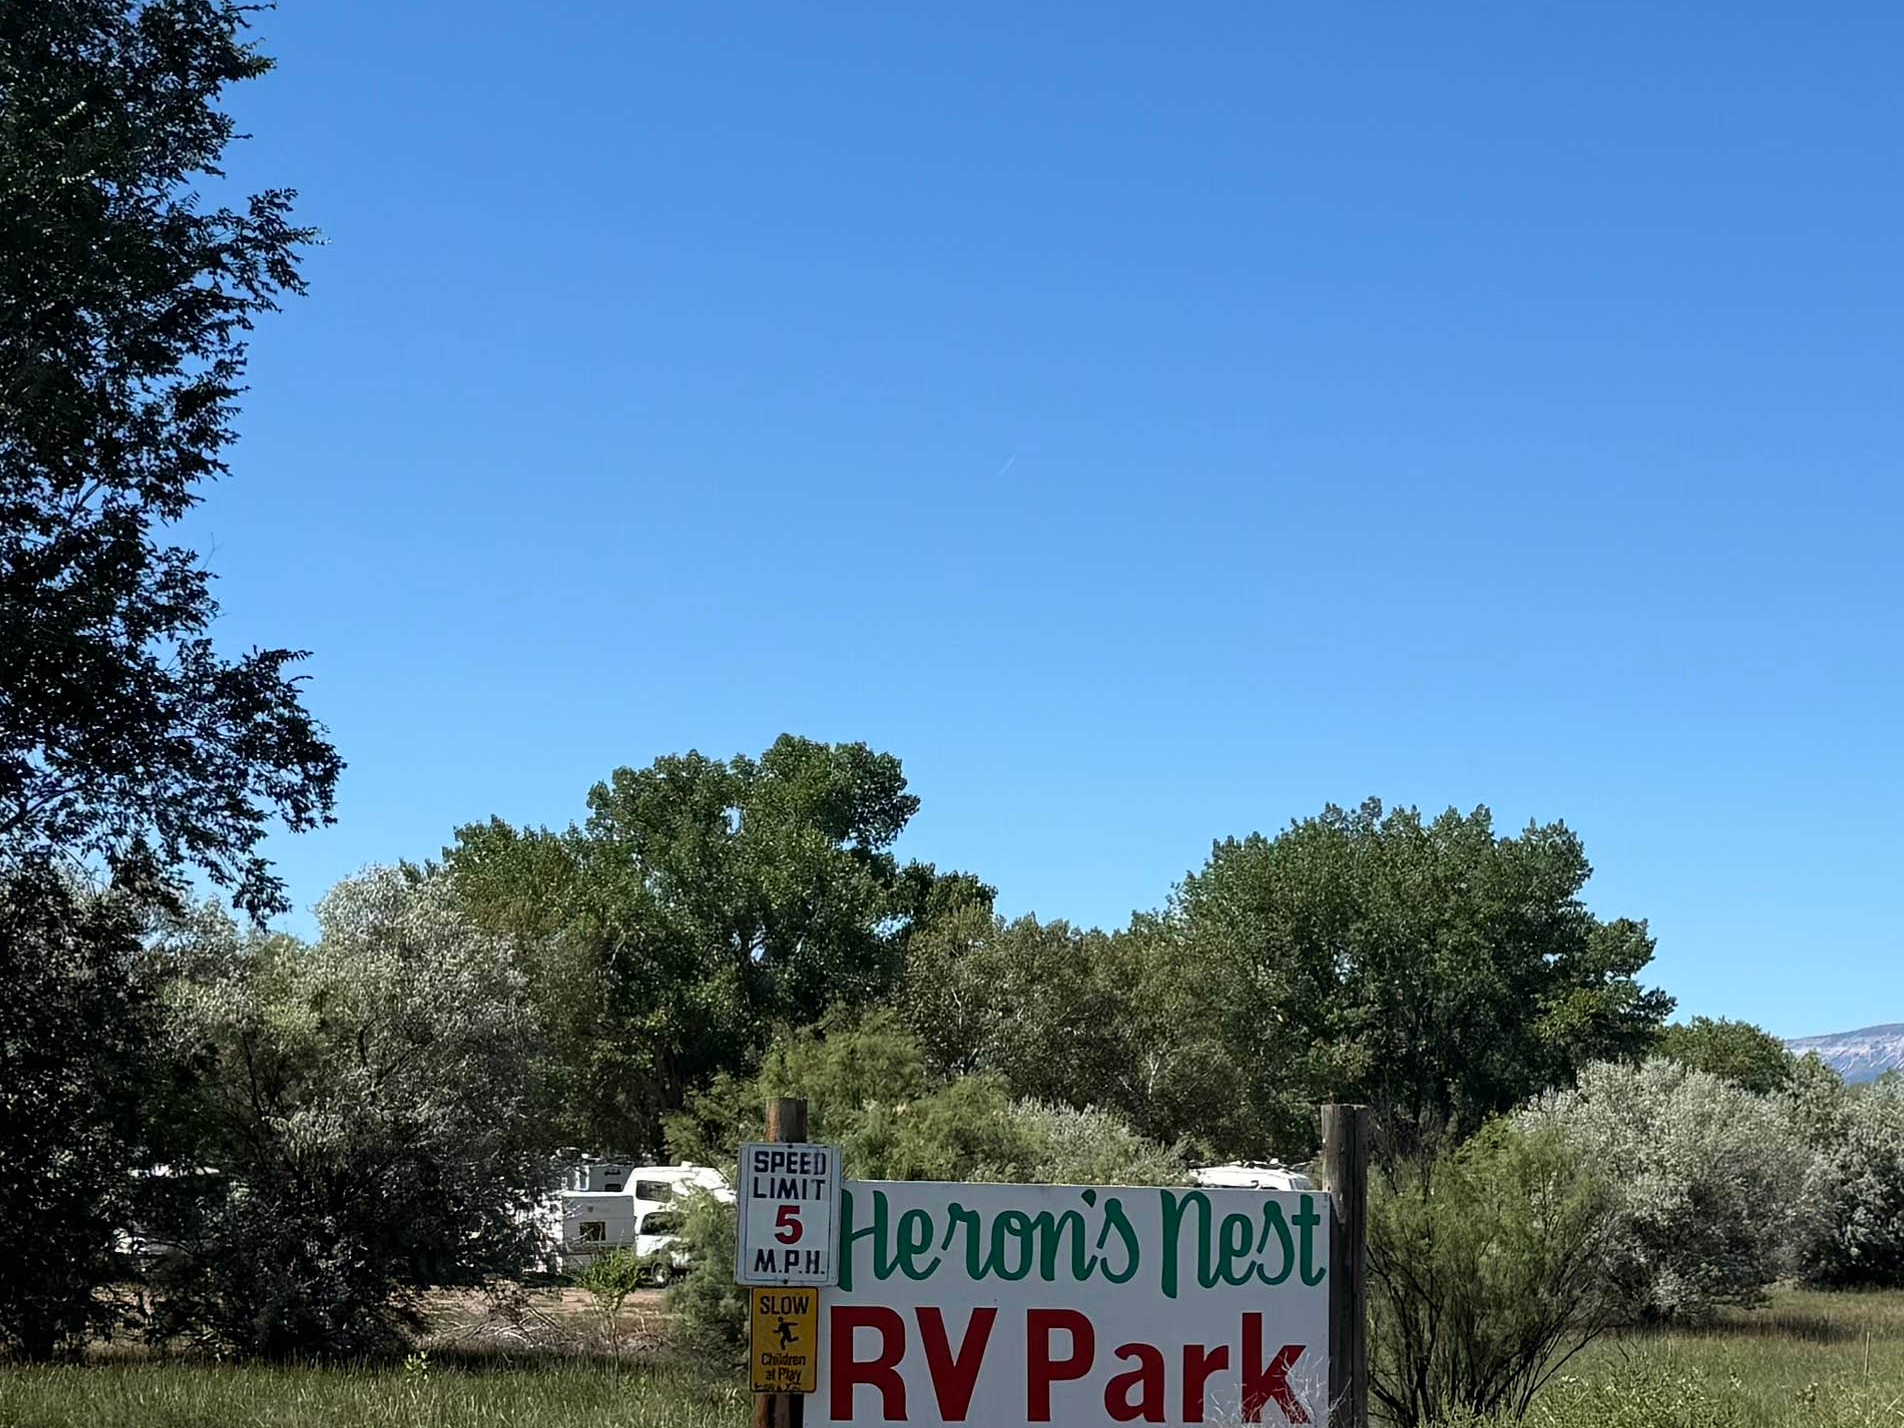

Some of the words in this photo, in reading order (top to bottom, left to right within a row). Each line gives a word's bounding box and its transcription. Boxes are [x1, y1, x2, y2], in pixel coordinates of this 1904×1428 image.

[754, 1151, 827, 1175] SPEED
[753, 1176, 826, 1200] LIMIT
[774, 1205, 804, 1245] 5
[838, 1188, 1140, 1292] Heron's
[1159, 1188, 1327, 1299] Nest
[754, 1248, 826, 1274] M.P.H.
[760, 1295, 810, 1315] SLOW
[761, 1352, 807, 1366] Children
[830, 1305, 999, 1422] RV
[1026, 1308, 1312, 1424] Park
[765, 1367, 777, 1381] at
[778, 1367, 802, 1384] Play
